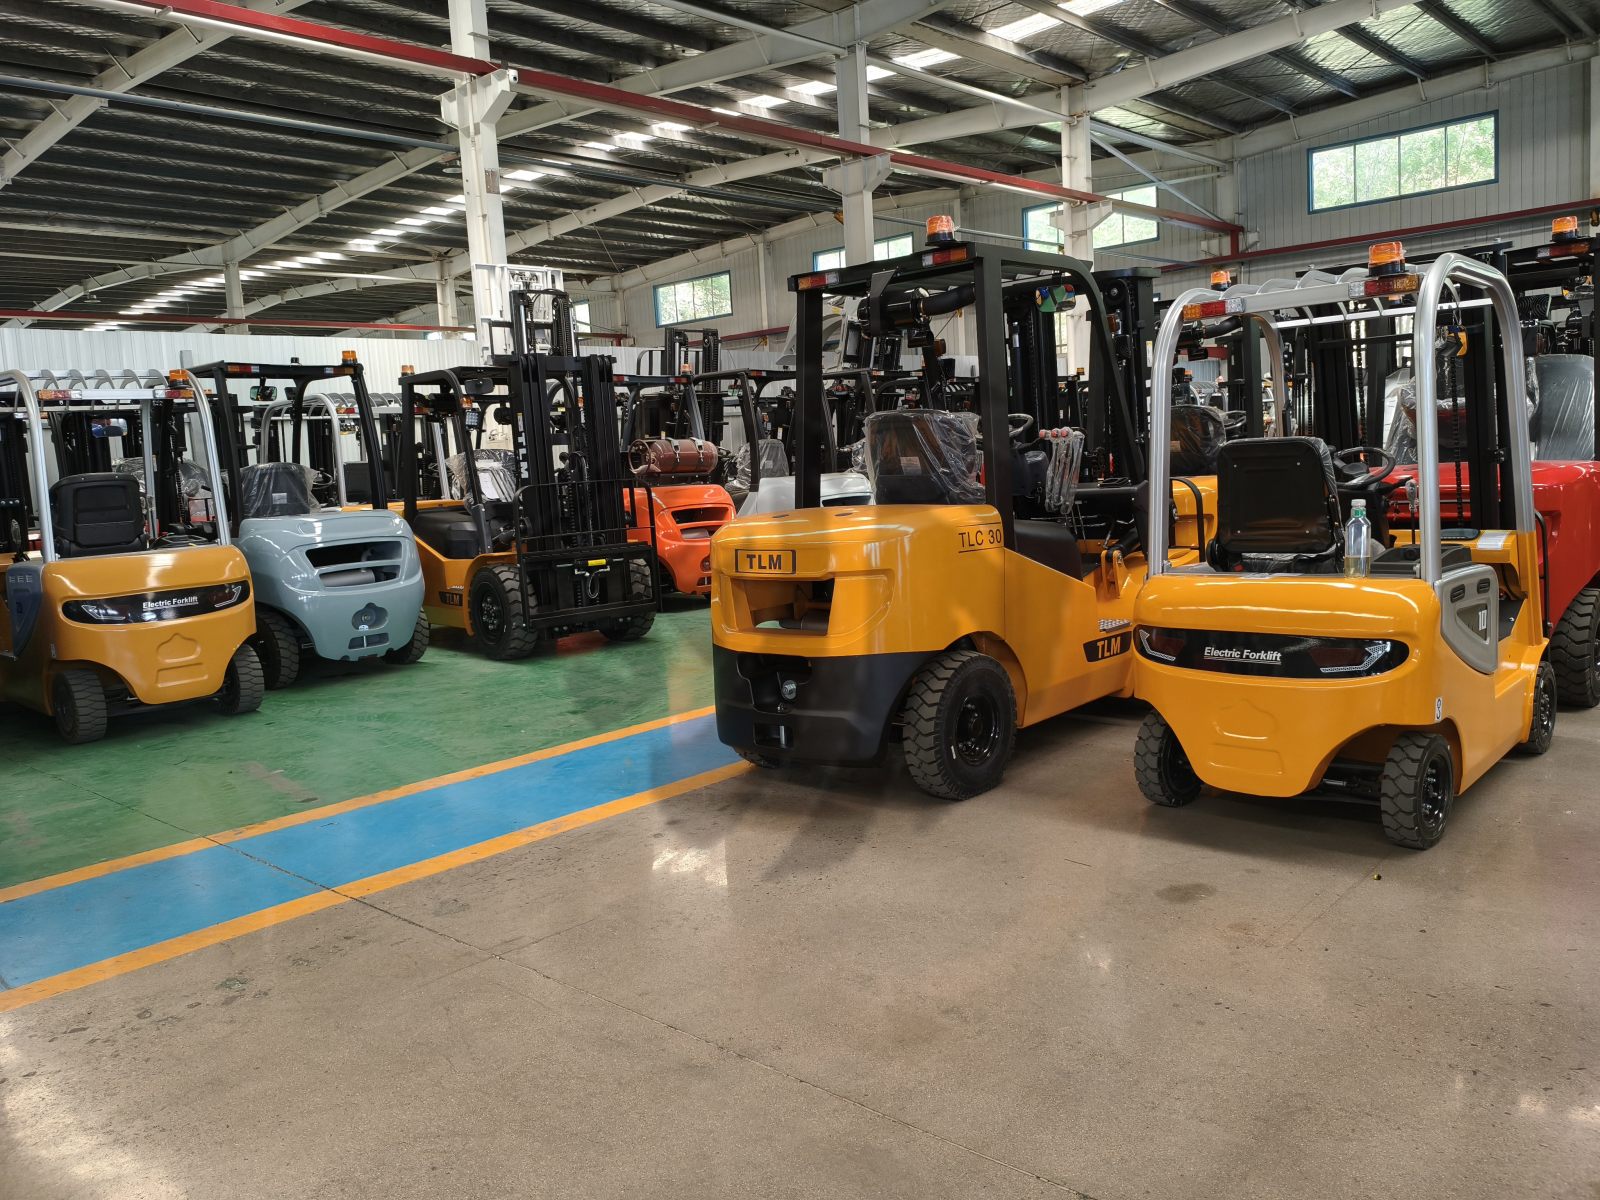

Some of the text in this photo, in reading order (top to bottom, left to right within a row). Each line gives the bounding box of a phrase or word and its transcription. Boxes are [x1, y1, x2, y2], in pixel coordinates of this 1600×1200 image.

[517, 432, 529, 479] TLM
[958, 528, 1002, 548] TLC 30
[746, 553, 782, 570] TLM
[142, 596, 198, 609] Electric Forklift
[1097, 636, 1120, 659] TLM
[1204, 646, 1281, 661] Electric Forklift
